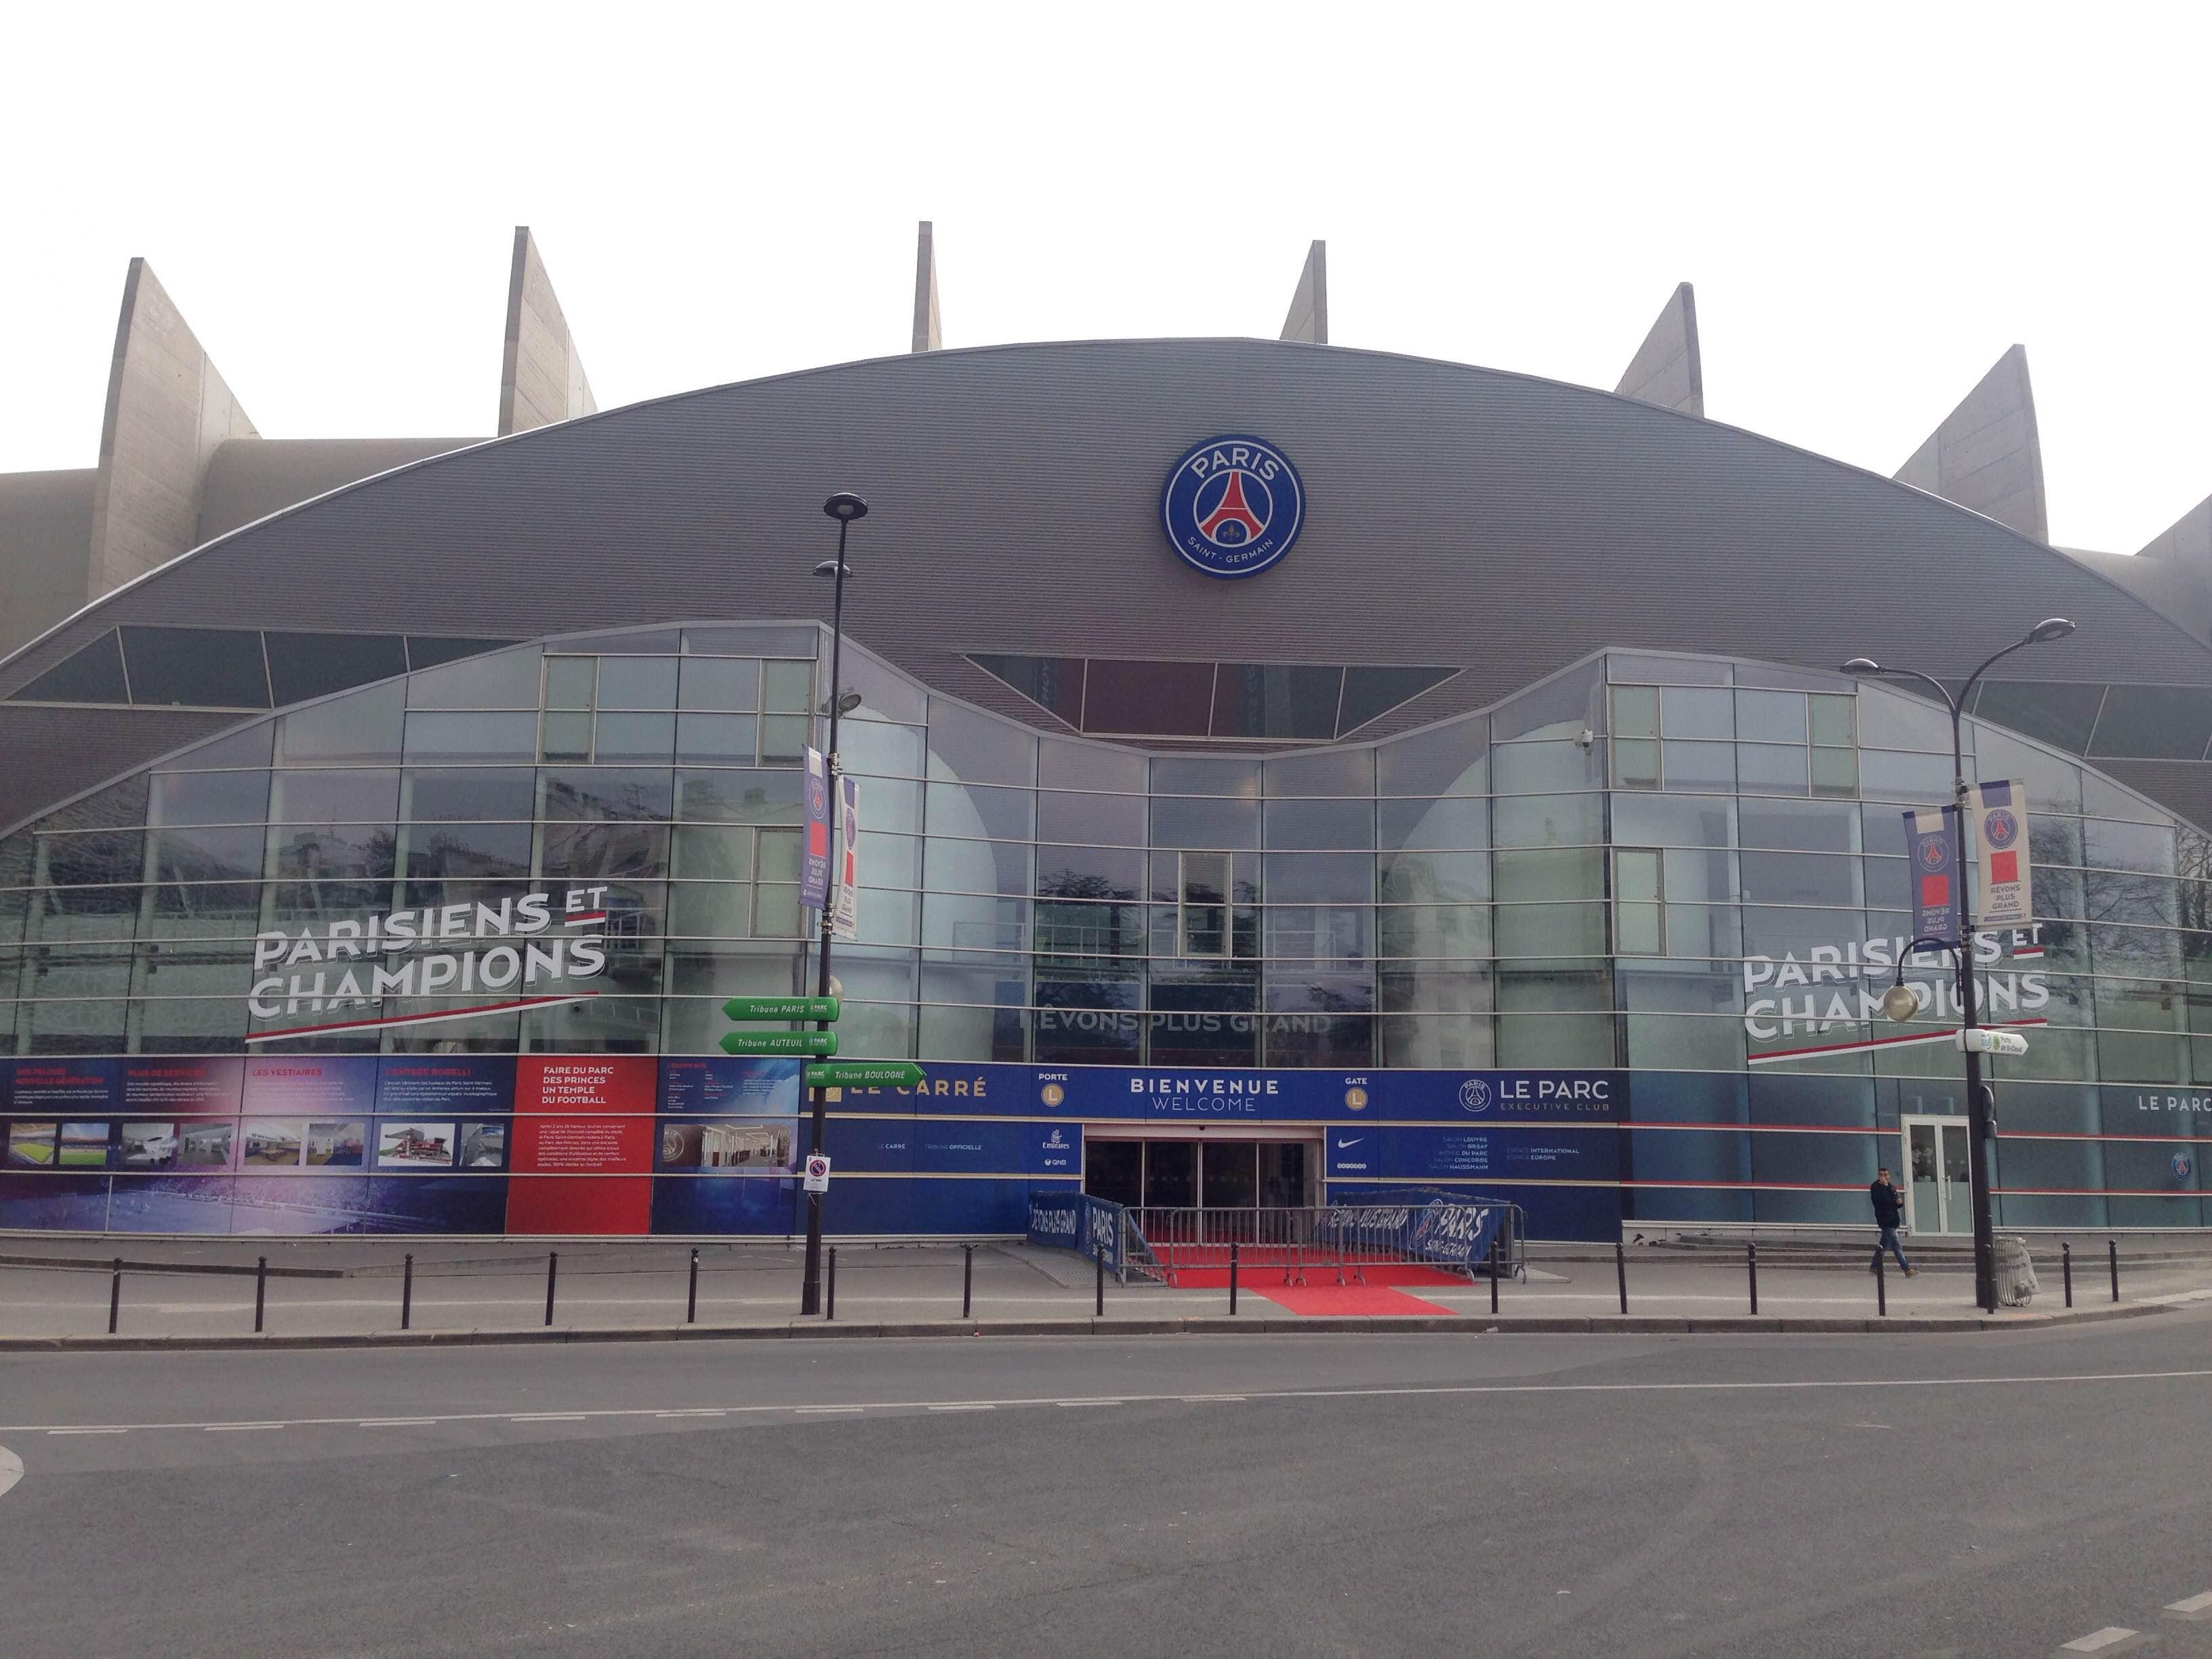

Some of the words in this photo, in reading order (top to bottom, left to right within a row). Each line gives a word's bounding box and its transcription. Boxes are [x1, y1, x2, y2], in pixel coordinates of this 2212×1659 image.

[1191, 447, 1279, 480] PARIS
[1992, 901, 2020, 909] GRAND
[253, 893, 552, 972] PARISIENS
[565, 886, 608, 913] ET
[2012, 923, 2043, 946] ET
[248, 935, 605, 1021] CHAMPIONS
[750, 1005, 779, 1013] Tribune
[781, 1005, 805, 1013] PARIS
[1149, 1013, 1221, 1031] PLUS
[737, 1039, 766, 1047] Tribune
[771, 1039, 803, 1047] AUTEUIL
[270, 1068, 323, 1077] VESTIAIRES
[835, 1071, 862, 1080] Tribune
[865, 1071, 905, 1079] BOULOGNE
[1038, 1073, 1068, 1081] PORTE
[1131, 1078, 1279, 1094] BIENVENUE
[1500, 1080, 1530, 1099] LE
[1539, 1080, 1609, 1099] PARC
[1048, 1088, 1058, 1101] L
[1352, 1092, 1362, 1105] L
[1152, 1097, 1256, 1111] WELCOME
[1501, 1103, 1570, 1111] EXECUTIVE
[1576, 1103, 1610, 1111] CLUB
[2138, 1095, 2159, 1111] LE
[2167, 1097, 2212, 1112] PARC
[1092, 1207, 1113, 1247] PARIS
